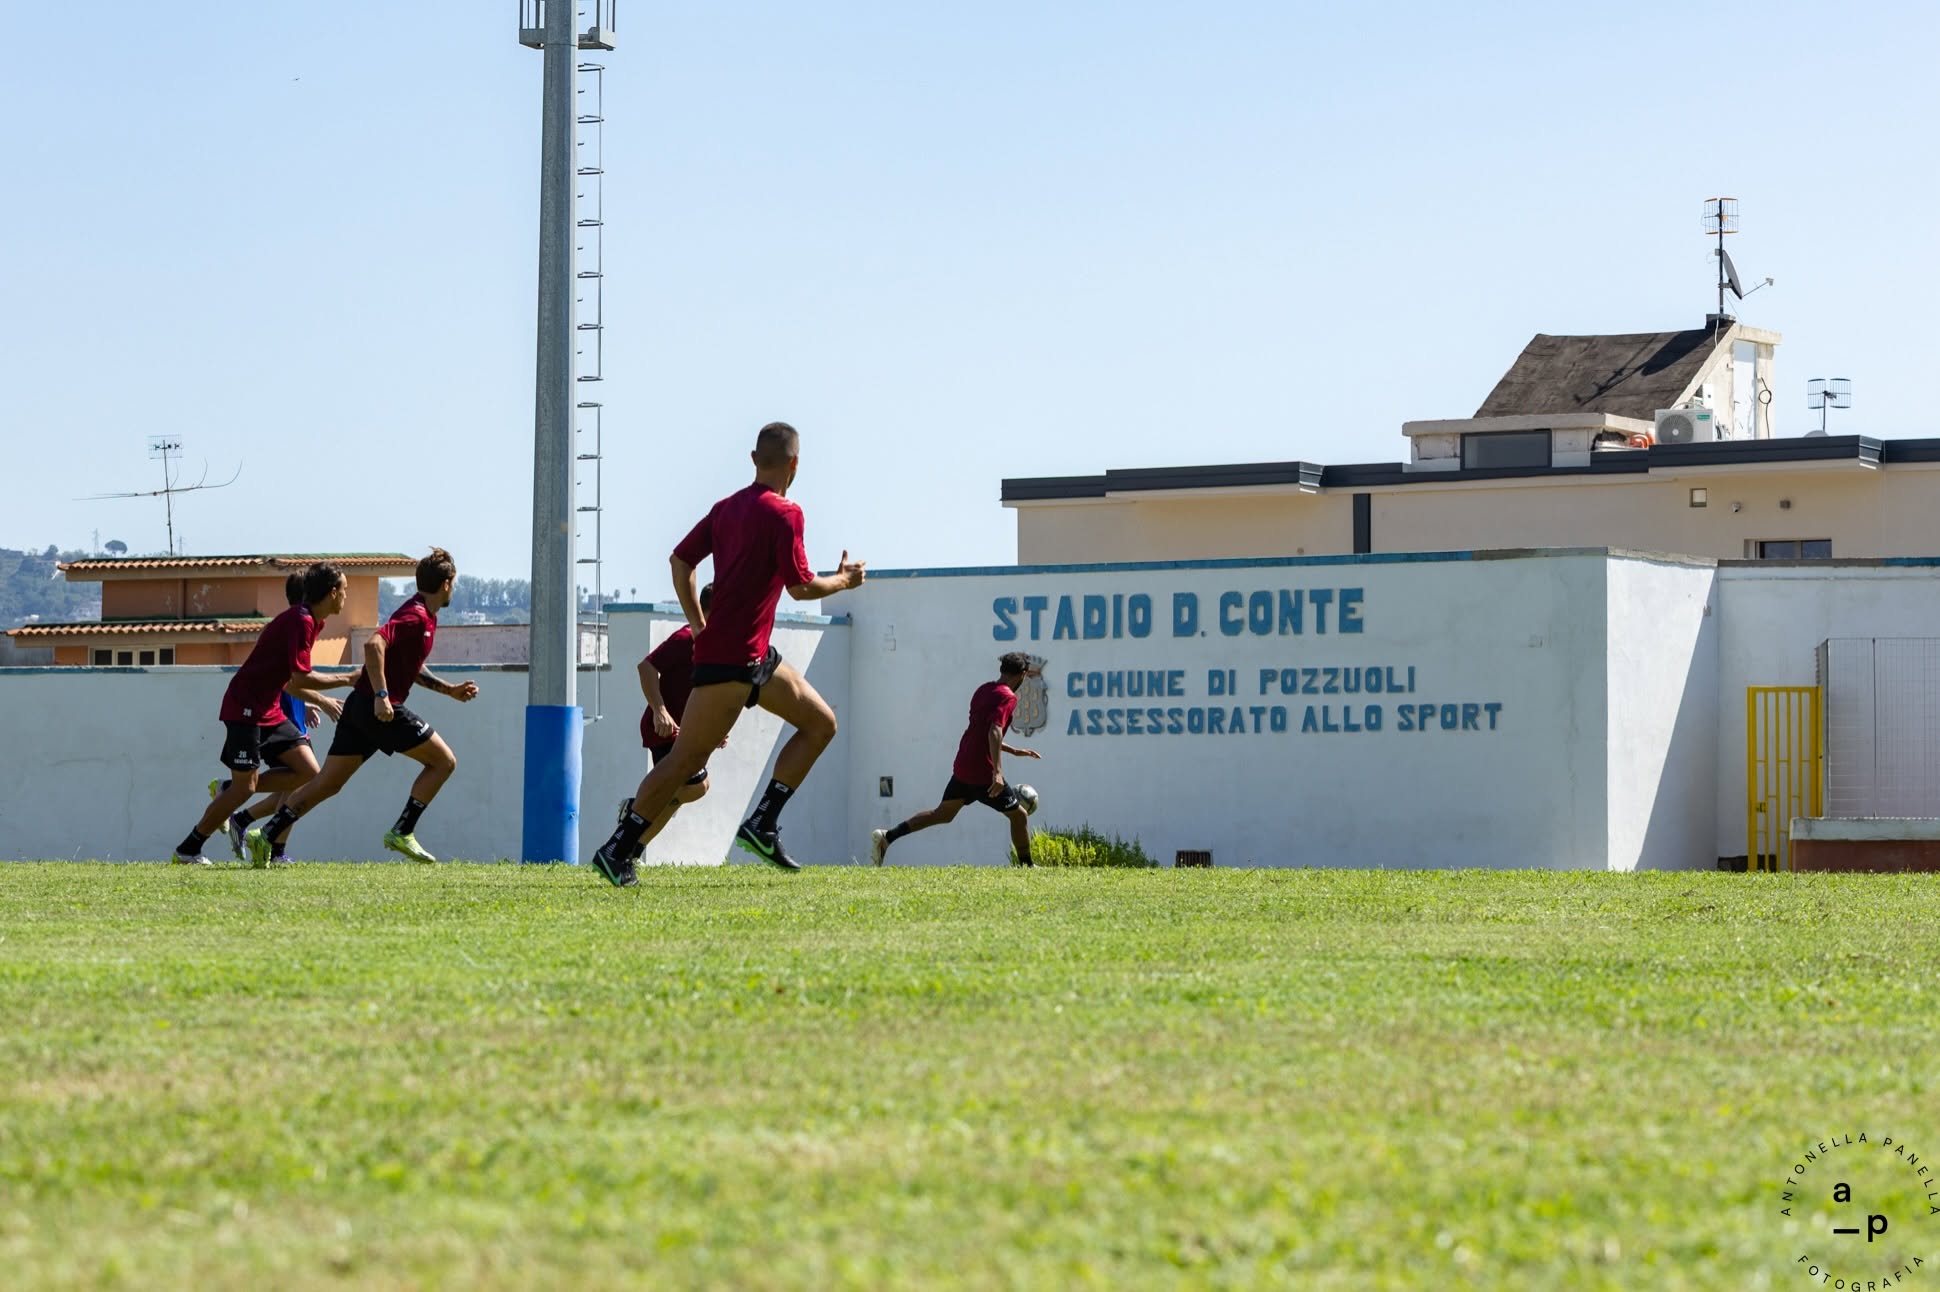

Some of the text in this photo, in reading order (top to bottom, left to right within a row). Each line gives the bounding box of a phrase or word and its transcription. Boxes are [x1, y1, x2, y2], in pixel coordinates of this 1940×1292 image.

[992, 593, 1152, 641] STADIO
[1219, 588, 1364, 636] CONTE
[1066, 666, 1416, 697] COMUNE DI POZZUOLI
[1067, 703, 1502, 735] ASSESSORATO ALLO SPORT
